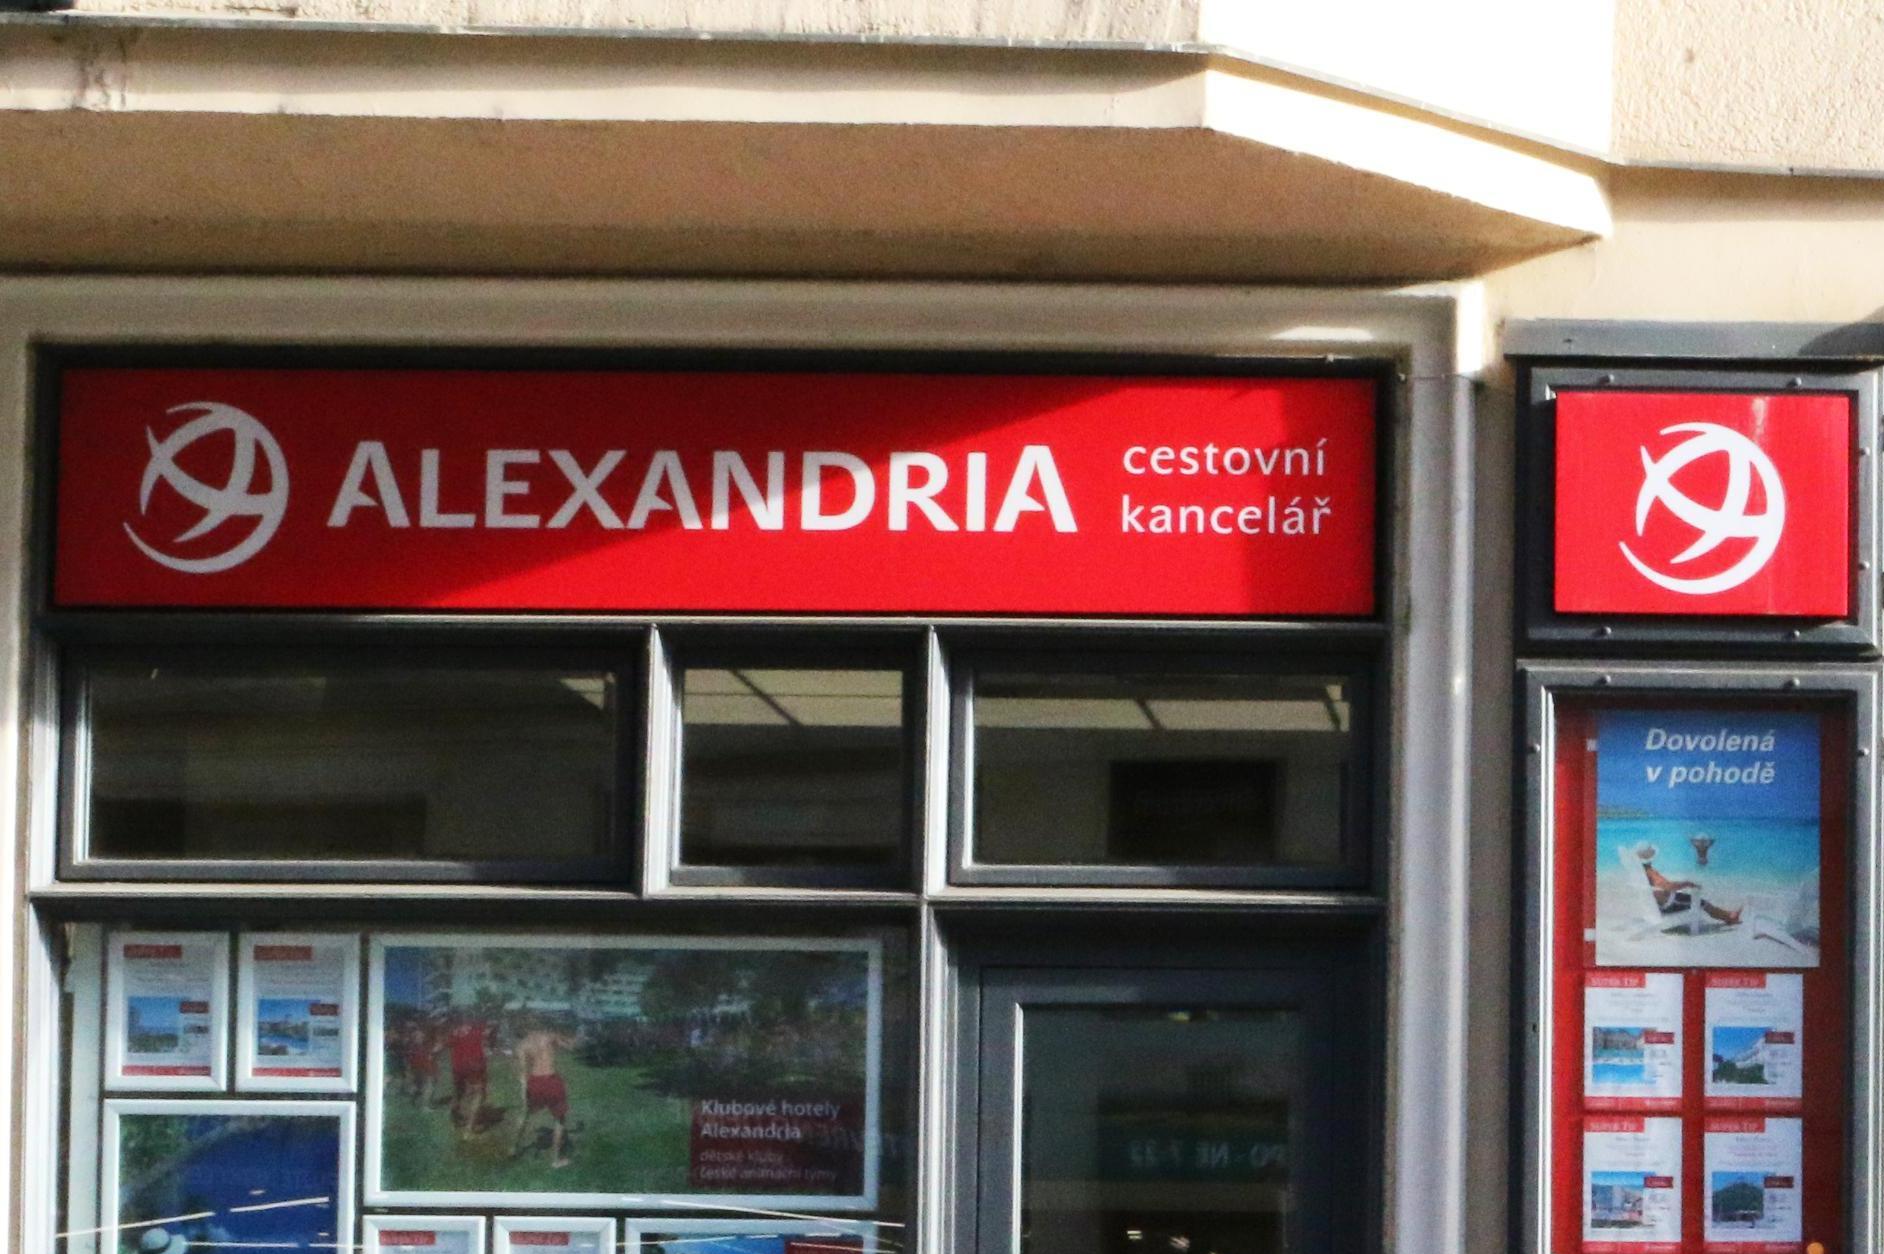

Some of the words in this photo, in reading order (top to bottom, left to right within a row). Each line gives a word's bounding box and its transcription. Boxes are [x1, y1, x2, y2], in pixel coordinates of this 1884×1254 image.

[1122, 438, 1328, 476] cestovní
[326, 440, 1078, 533] ALEXANDRIA
[1120, 494, 1332, 535] kancelář
[1644, 727, 1776, 752] Dovolená
[1645, 766, 1664, 784] v
[1668, 760, 1776, 789] pohodě
[700, 1098, 777, 1115] Klubové
[782, 1098, 841, 1120] hotely
[699, 1121, 802, 1140] Alexandria
